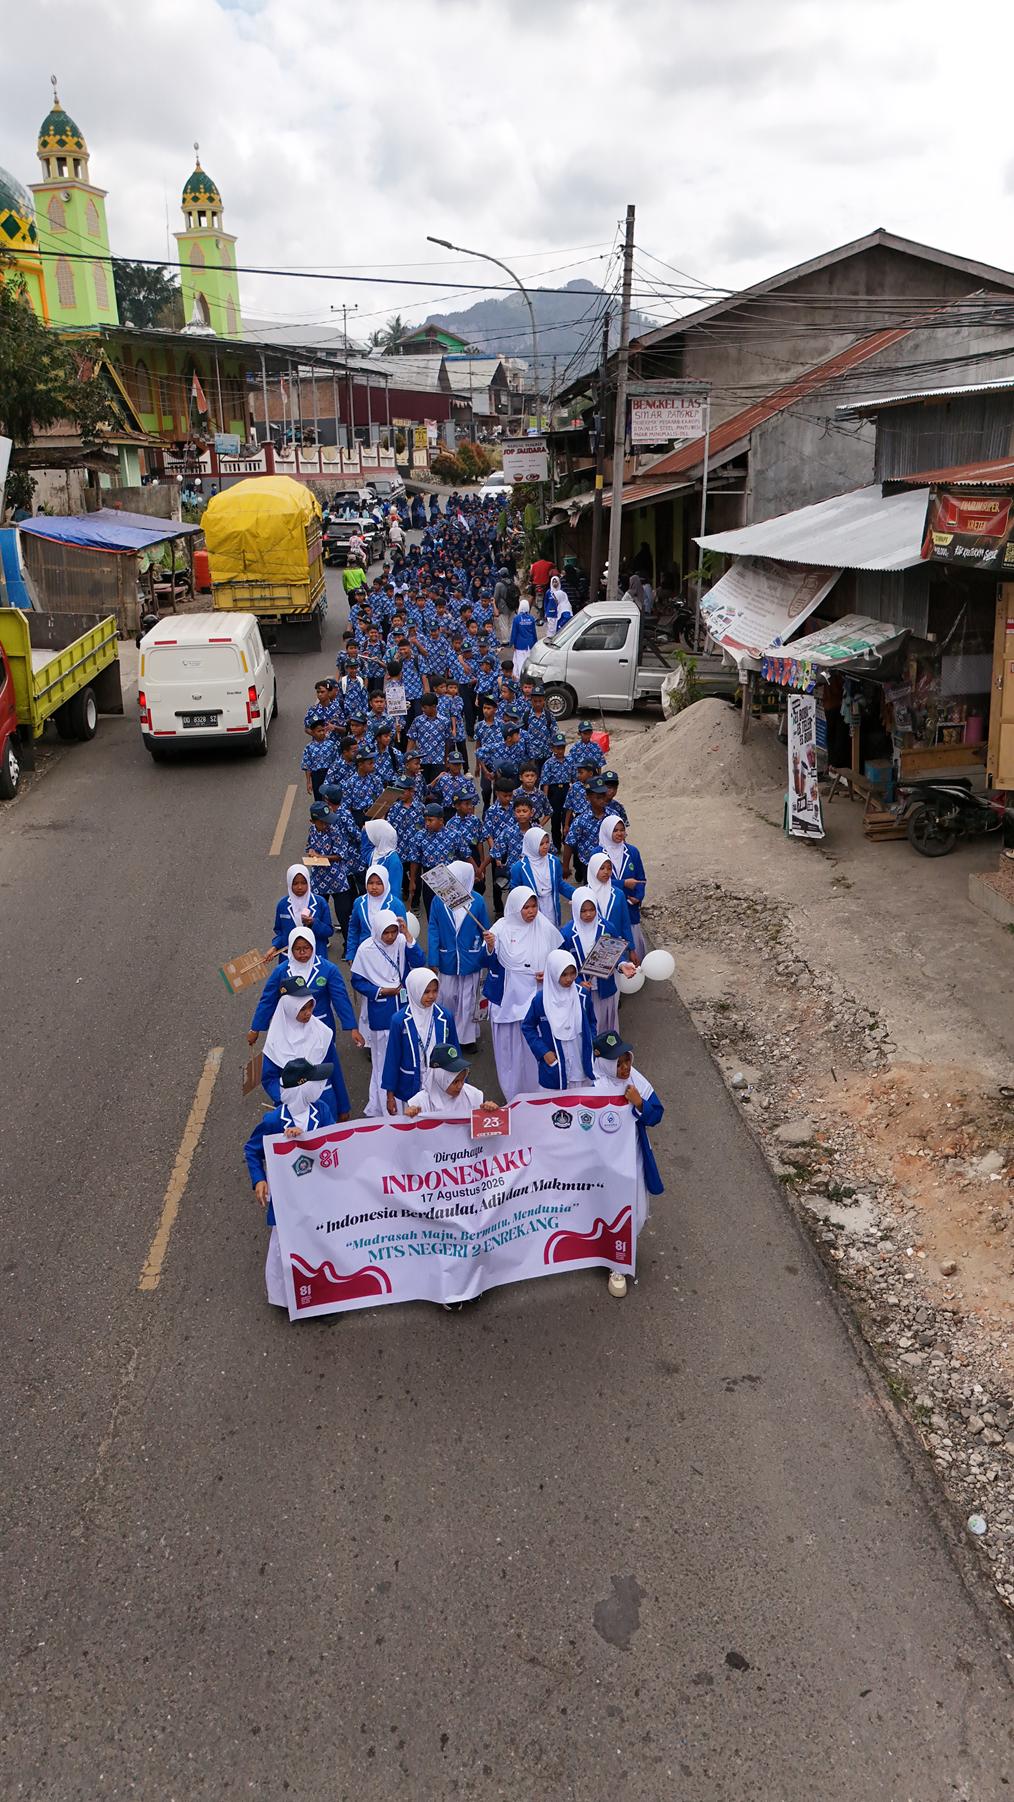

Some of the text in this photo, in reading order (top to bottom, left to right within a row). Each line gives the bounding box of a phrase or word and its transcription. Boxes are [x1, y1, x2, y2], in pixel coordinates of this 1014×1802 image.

[633, 399, 701, 410] BENGKEL LAS
[483, 1117, 500, 1128] 23
[319, 1148, 339, 1168] 81
[433, 1146, 483, 1163] Dirgahayu
[381, 1147, 532, 1194] INDONESIAKU
[420, 1177, 505, 1203] 17 Agustus 2026
[401, 1202, 478, 1220] Berdaulat,
[479, 1191, 506, 1212] Adil
[505, 1185, 529, 1201] dan
[368, 1216, 559, 1263] MTS NEGERI 2 ENREKANG
[420, 1230, 457, 1242] Maju,
[460, 1218, 510, 1241] Bermutu,
[615, 1240, 626, 1252] 81
[300, 1284, 311, 1296] 81
